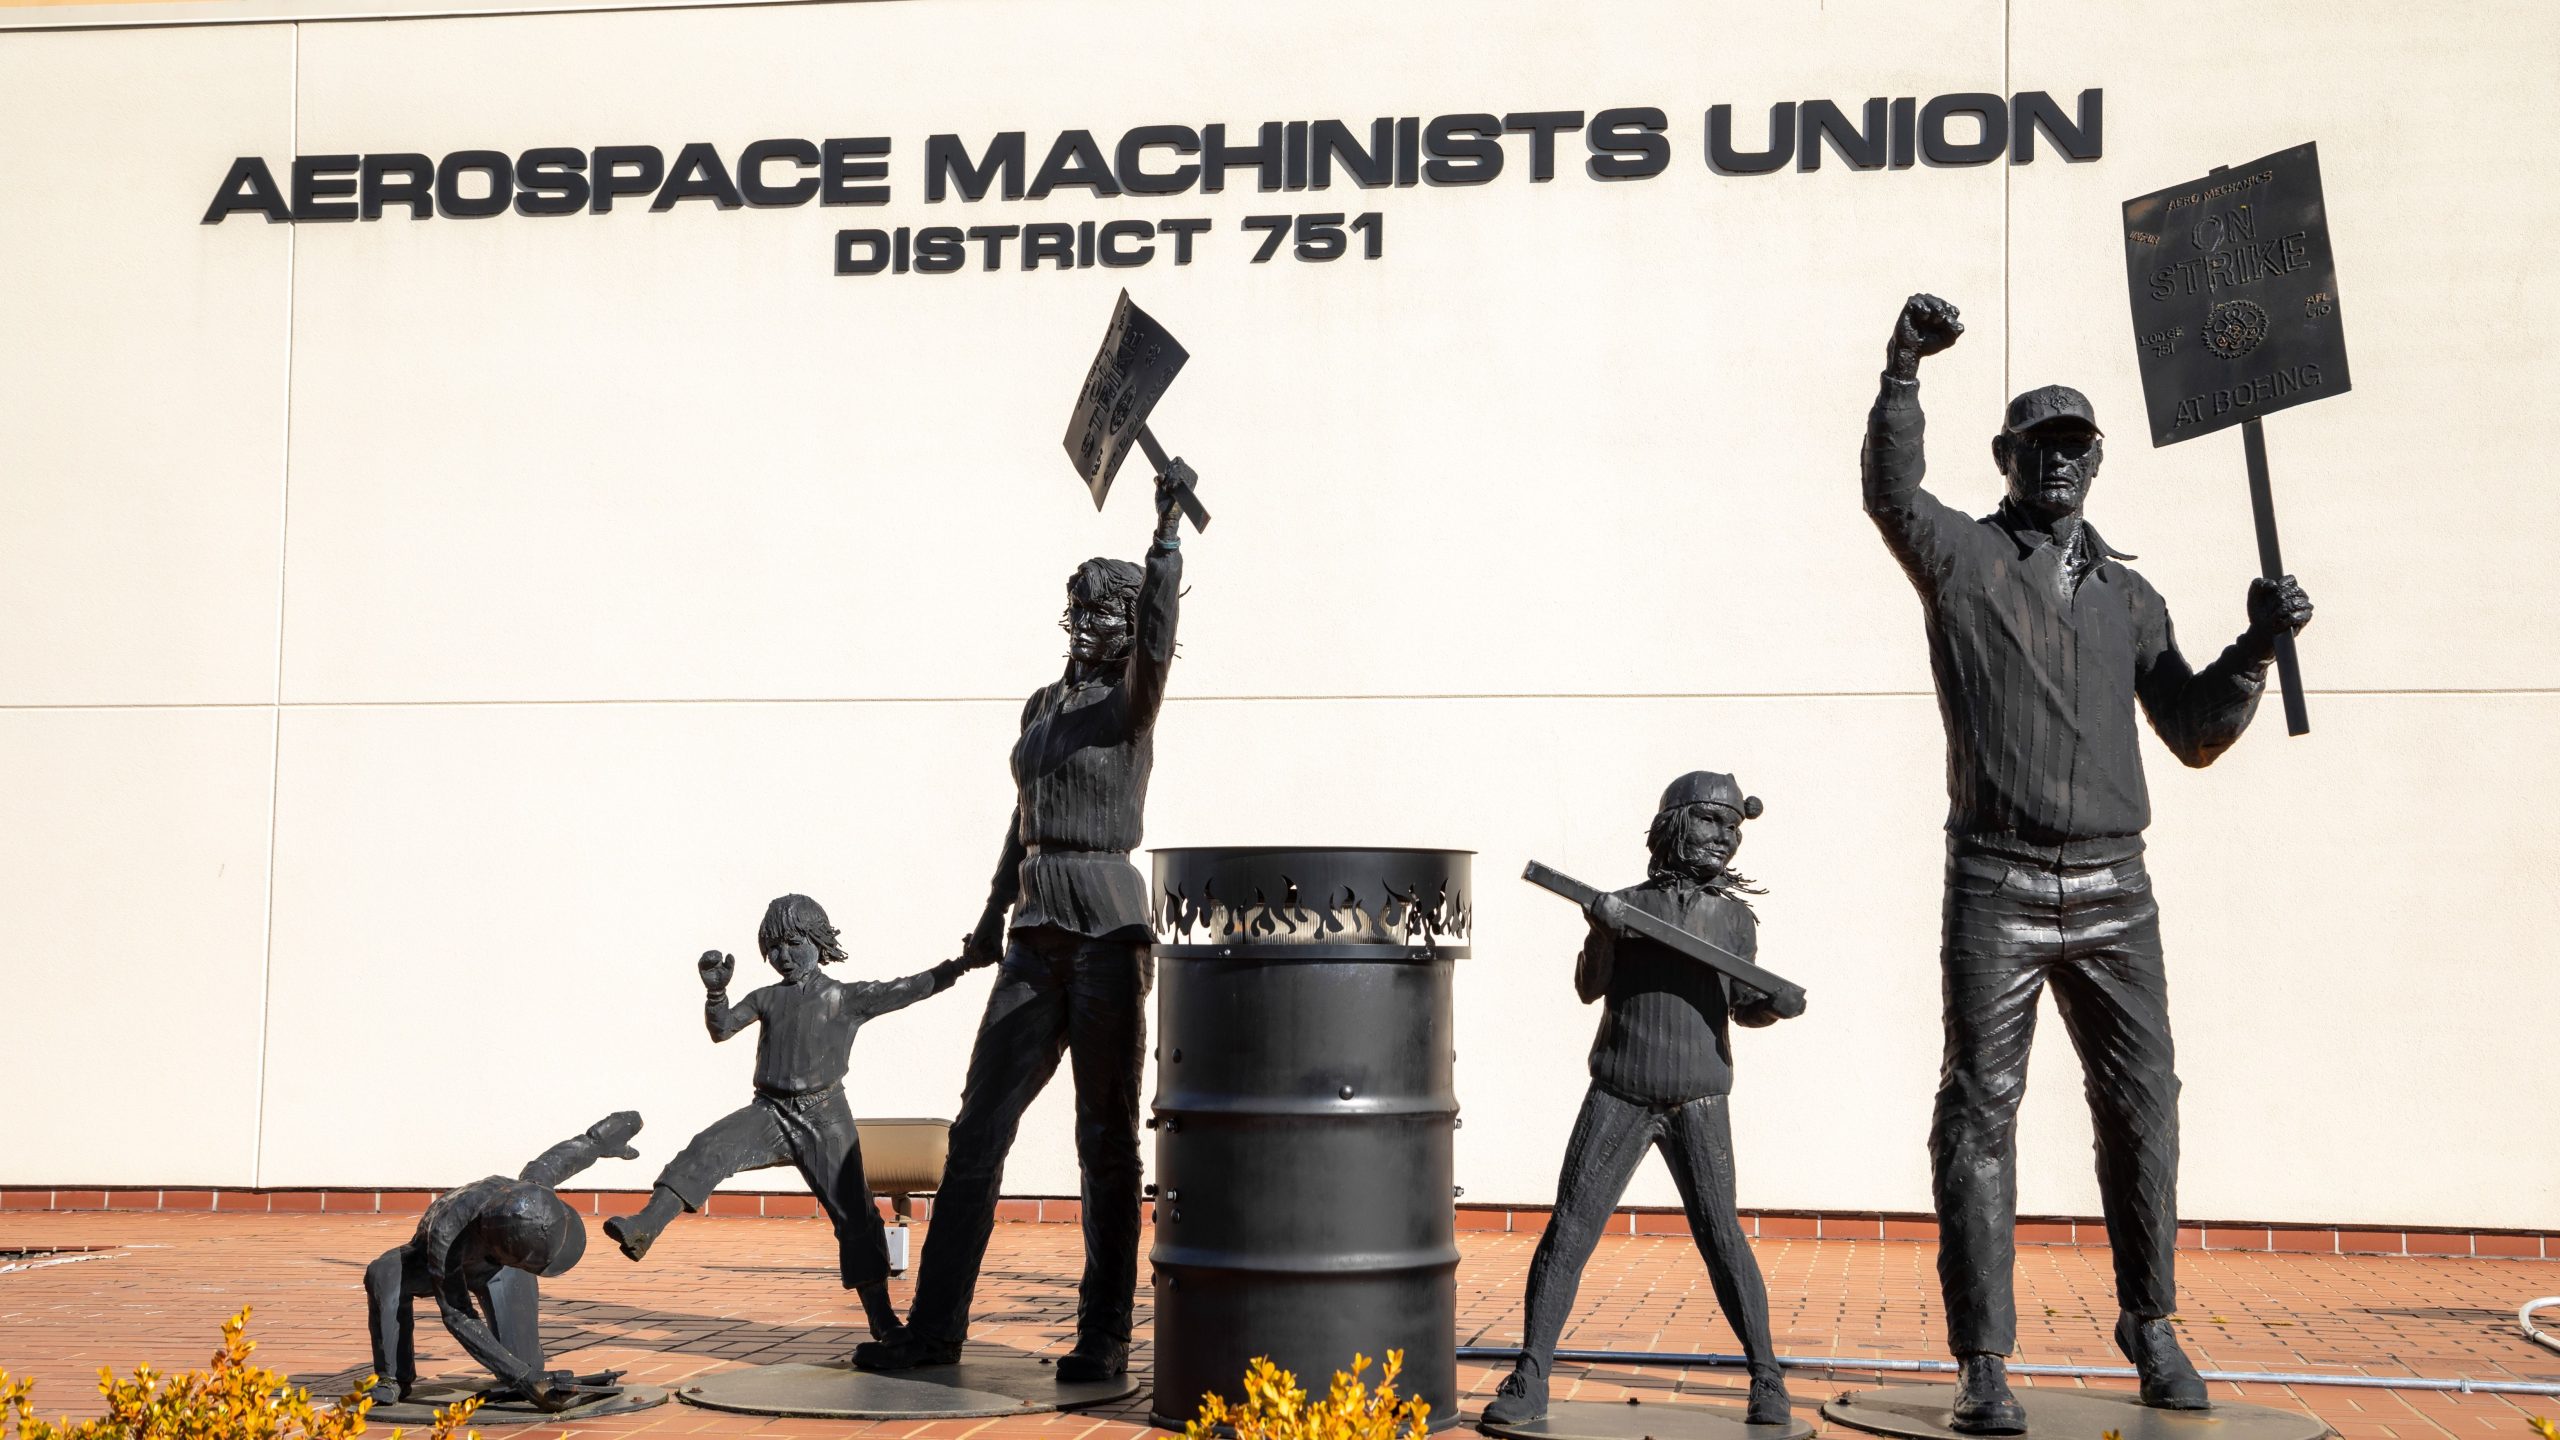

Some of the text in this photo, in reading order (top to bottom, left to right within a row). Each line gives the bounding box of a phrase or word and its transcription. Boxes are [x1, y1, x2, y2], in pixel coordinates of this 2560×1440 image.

[201, 89, 2102, 225] AEROSPACE MACHINISTS UNION
[2166, 170, 2272, 211] AERO MECHANICS
[836, 213, 1382, 274] DISTRICT 751
[2191, 206, 2256, 251] ON
[2150, 231, 2311, 301] STRIKE
[2139, 327, 2184, 347] LODGE
[2152, 342, 2175, 358] 751
[1081, 323, 1144, 458] STRIKE
[2173, 364, 2322, 429] AT BOEING
